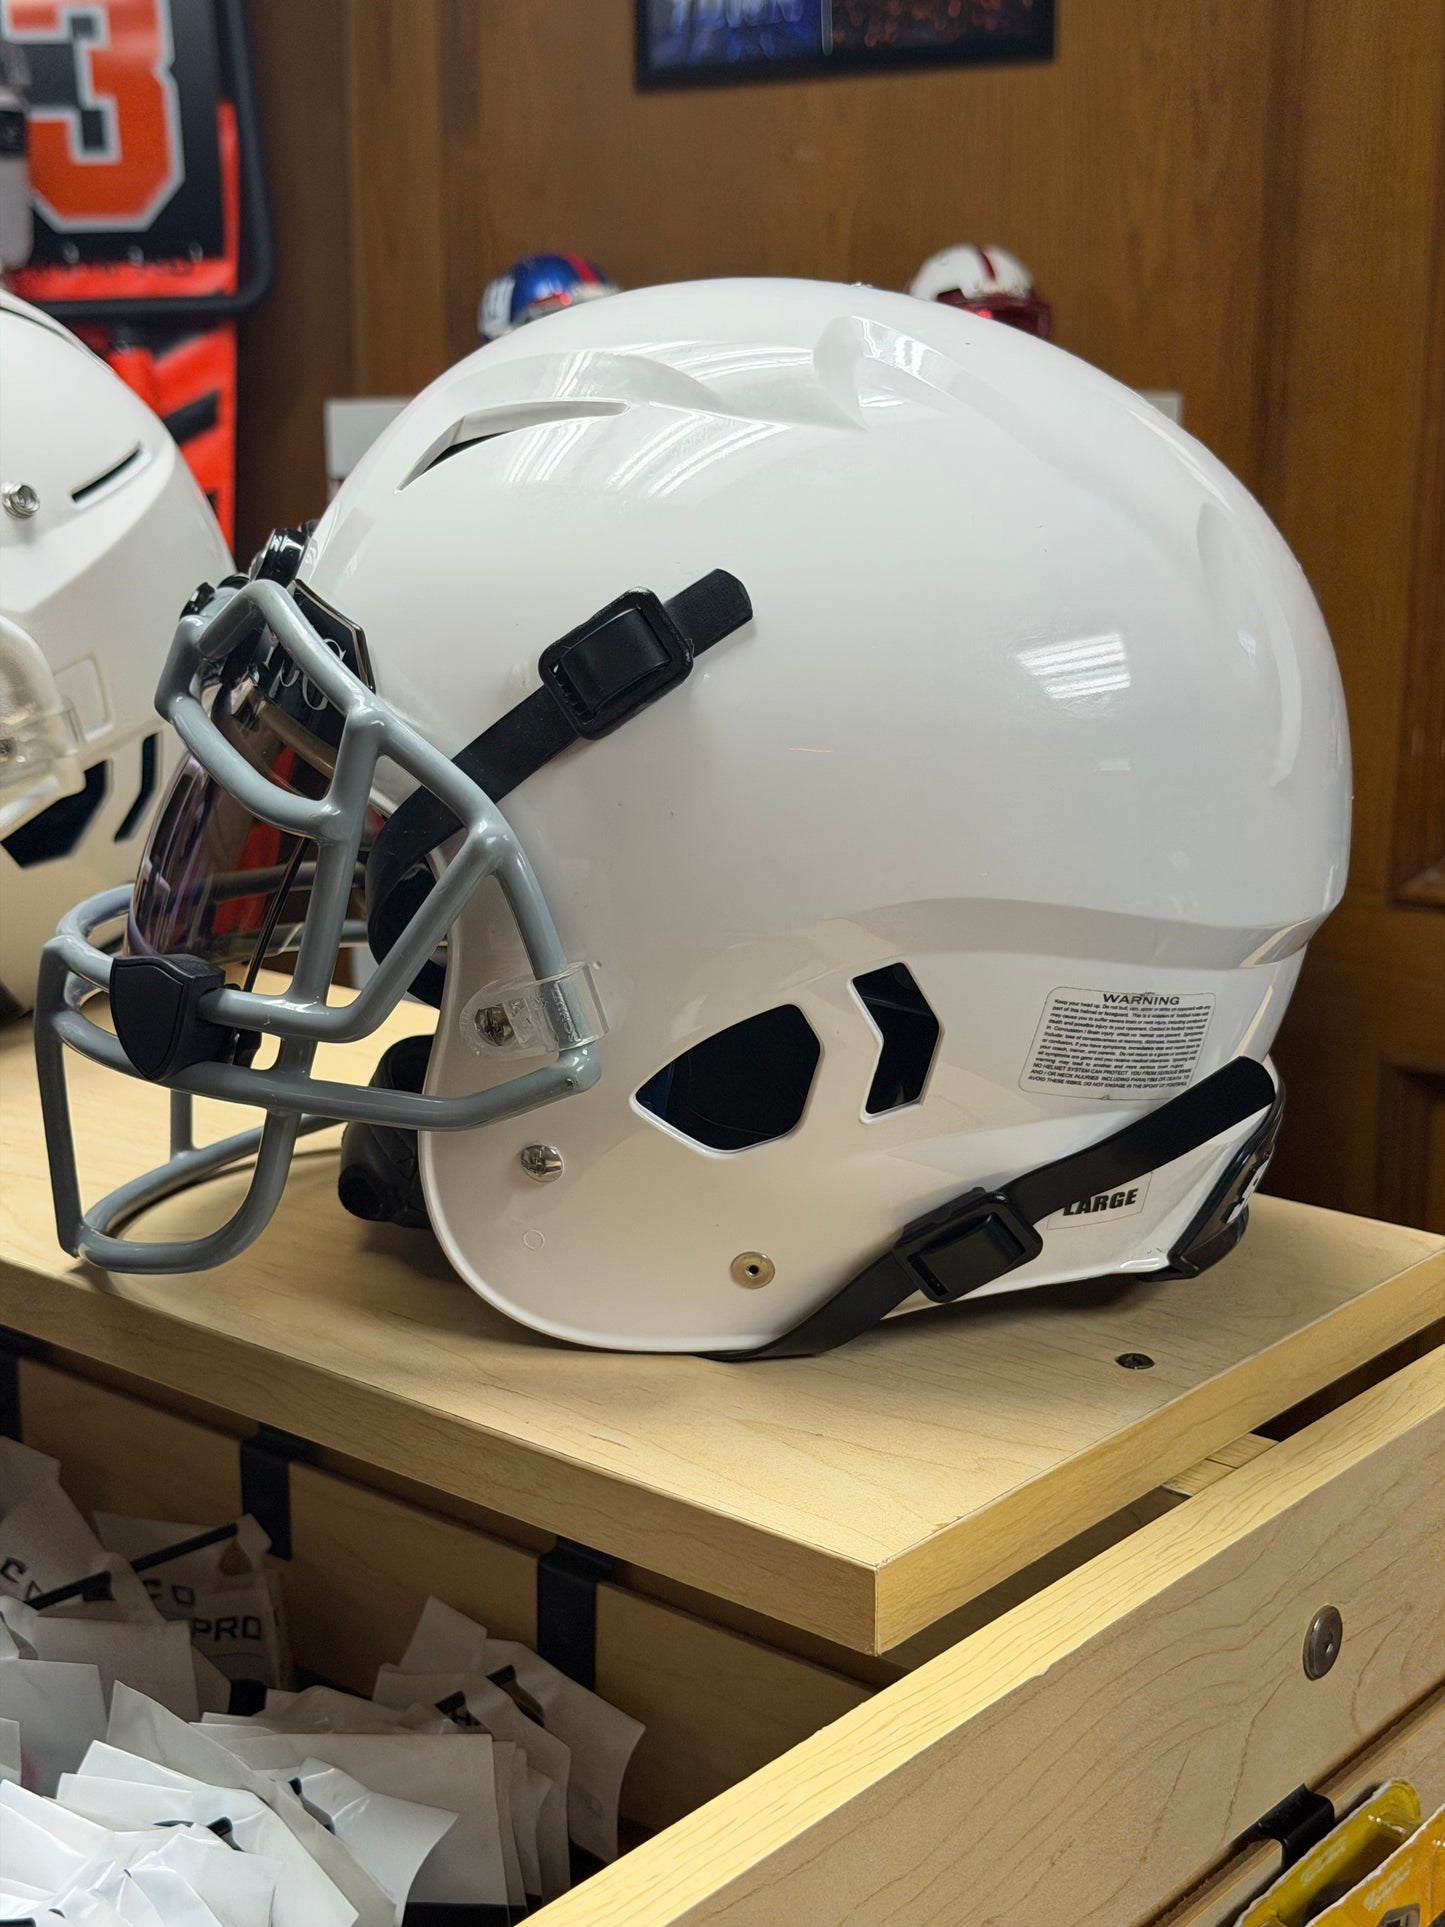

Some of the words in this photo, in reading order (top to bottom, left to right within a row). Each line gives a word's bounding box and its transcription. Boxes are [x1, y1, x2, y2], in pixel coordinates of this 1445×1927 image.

[2, 0, 186, 235] 3
[1103, 994, 1180, 1006] WARNING
[1063, 1188, 1139, 1217] LARGE
[191, 1615, 262, 1641] PRO
